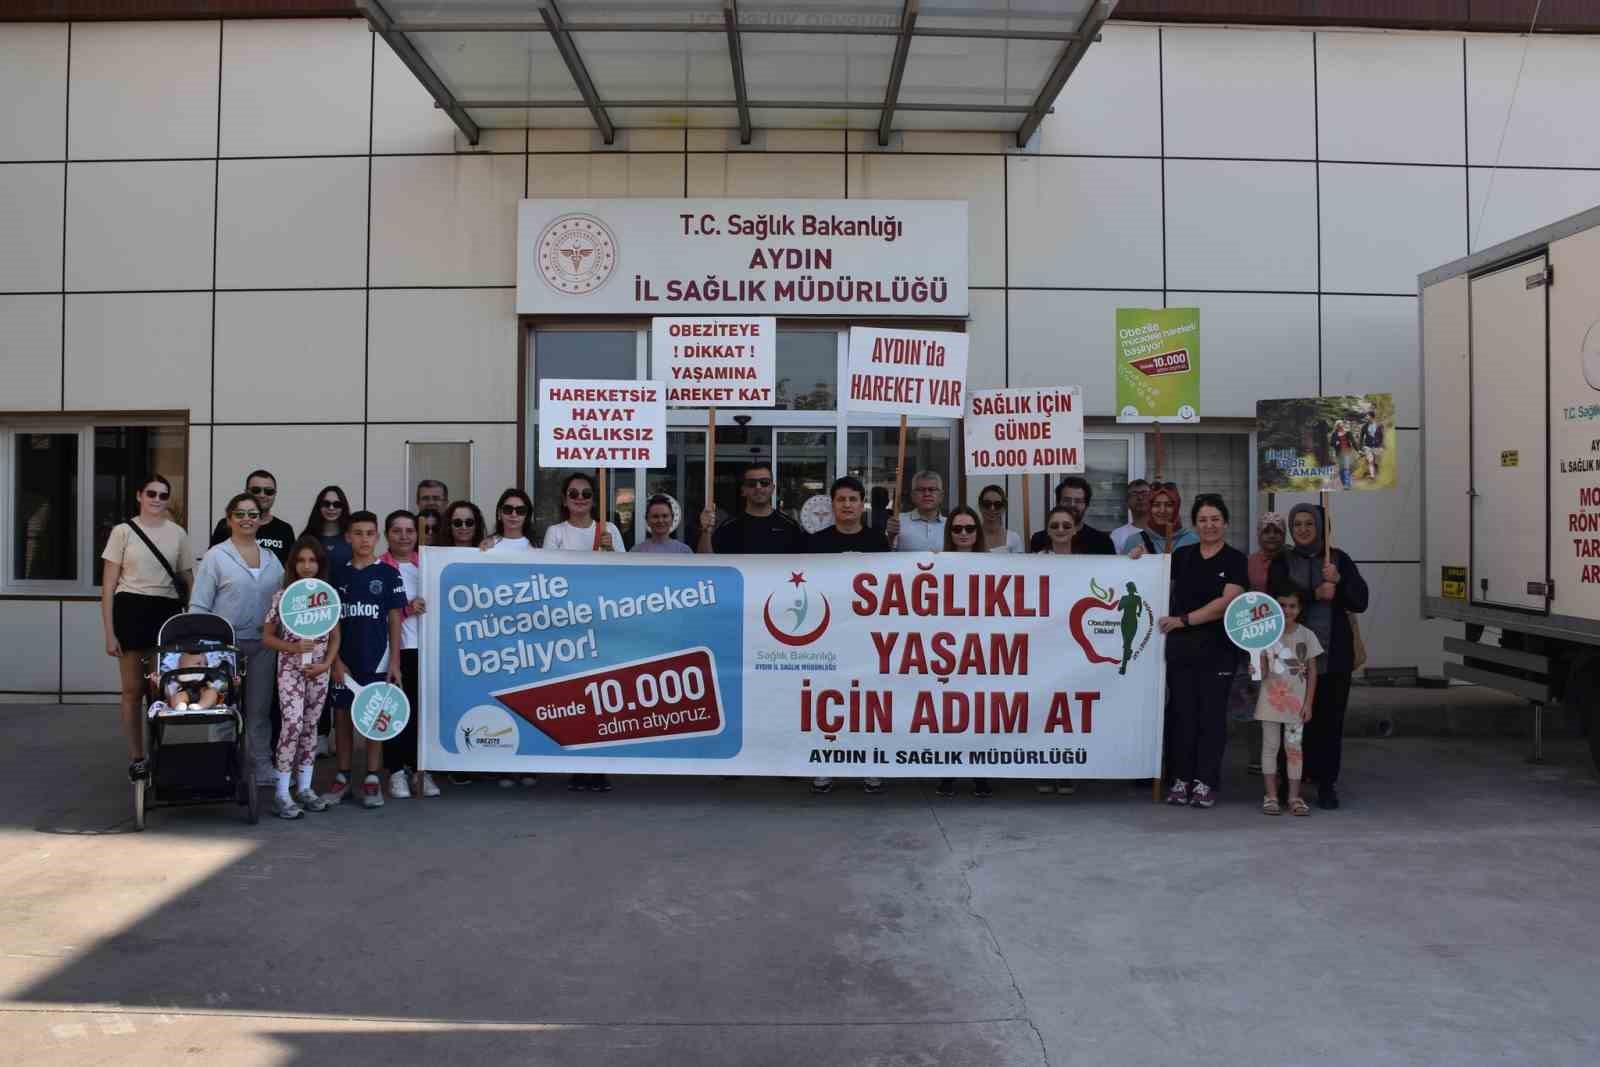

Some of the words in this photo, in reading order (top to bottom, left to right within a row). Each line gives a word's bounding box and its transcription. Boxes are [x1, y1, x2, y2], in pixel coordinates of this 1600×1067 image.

[680, 214, 721, 235] T.C.
[728, 213, 794, 241] Sağlık
[802, 215, 902, 242] Bakanlığı
[749, 248, 832, 270] AYDIN
[634, 275, 659, 301] İL
[666, 275, 766, 301] SAĞLIK
[774, 276, 948, 303] MÜDÜRLÜĞÜ
[669, 321, 760, 337] OBEZİTEYE
[684, 342, 744, 358] DİKKAT
[871, 337, 945, 367] AYDIN'da
[1152, 353, 1186, 369] 10.000
[672, 366, 757, 382] YAŞAMINA
[549, 387, 656, 403] HAREKETSİZ
[739, 388, 771, 401] KAT
[850, 374, 925, 403] HAREKET
[929, 379, 961, 406] VAR
[572, 408, 635, 421] HAYAT
[972, 393, 1031, 416] SAĞLIK
[1036, 391, 1072, 416] İÇİN
[553, 425, 653, 441] SAĞLIKSIZ
[995, 420, 1052, 441] GÜNDE
[556, 447, 650, 461] HAYATTIR
[971, 449, 1027, 469] 10.000
[1032, 447, 1077, 466] ADIM
[1569, 457, 1594, 473] SAĞLIK
[448, 573, 569, 613] Obezite
[852, 562, 1050, 617] SAĞLIKLI
[453, 602, 593, 642] mücadele
[600, 580, 716, 621] hareketi
[457, 629, 599, 677] başlıyor!
[871, 631, 1029, 684] YAŞAM
[536, 702, 586, 721] Günde
[584, 665, 705, 716] 10.000
[597, 714, 640, 736] adım
[643, 706, 712, 732] atıyoruz.
[800, 679, 893, 742] İÇİN
[910, 691, 1029, 734] ADIM
[1044, 691, 1101, 734] AT
[809, 749, 866, 764] AYDIN
[873, 747, 889, 764] İL
[895, 748, 963, 765] SAĞLIK
[968, 748, 1088, 765] MÜDÜRLÜĞÜ
